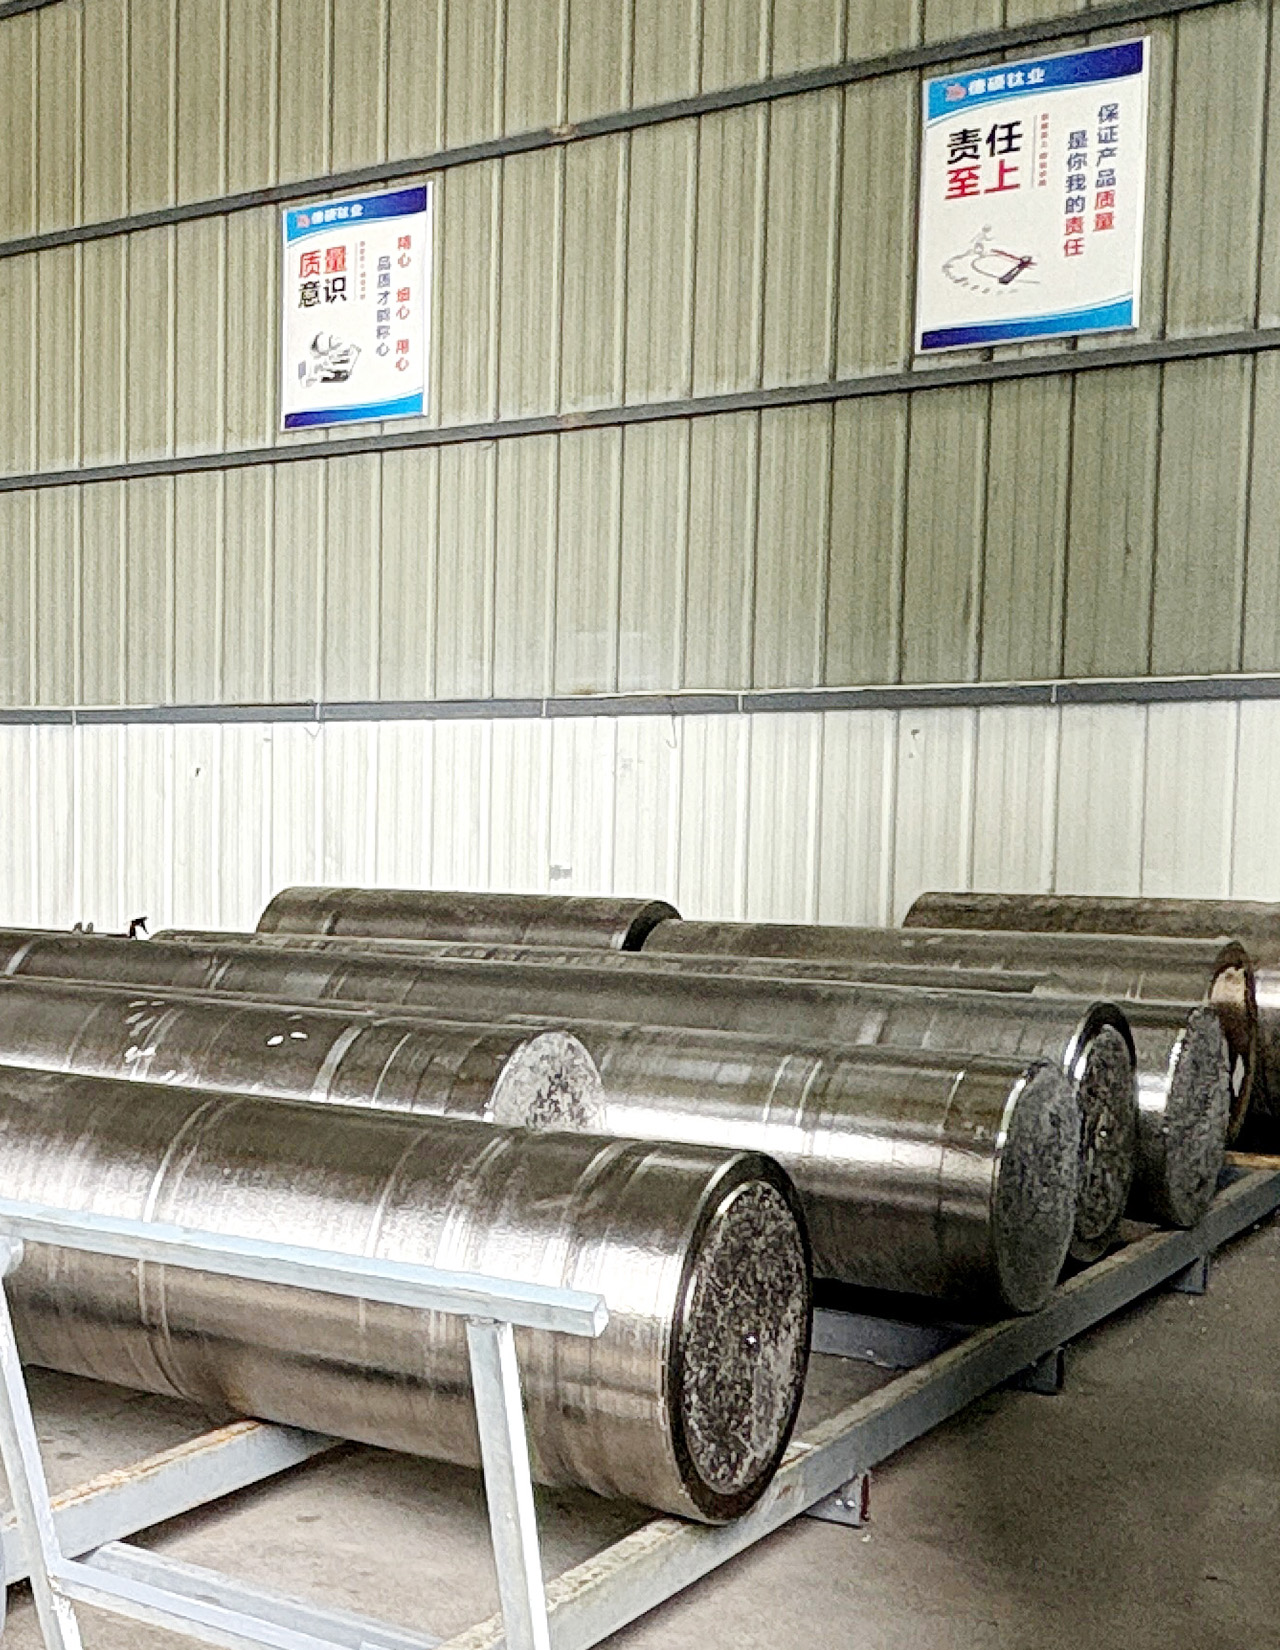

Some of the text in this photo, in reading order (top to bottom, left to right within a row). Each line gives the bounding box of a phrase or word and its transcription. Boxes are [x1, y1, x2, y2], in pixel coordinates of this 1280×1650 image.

[947, 120, 1023, 165] 责任
[944, 158, 1021, 200] 至上
[1092, 103, 1119, 232] 保证产品质量
[1063, 129, 1088, 258] 是你我的责任
[298, 245, 347, 278] 质量
[298, 276, 347, 308] 意识
